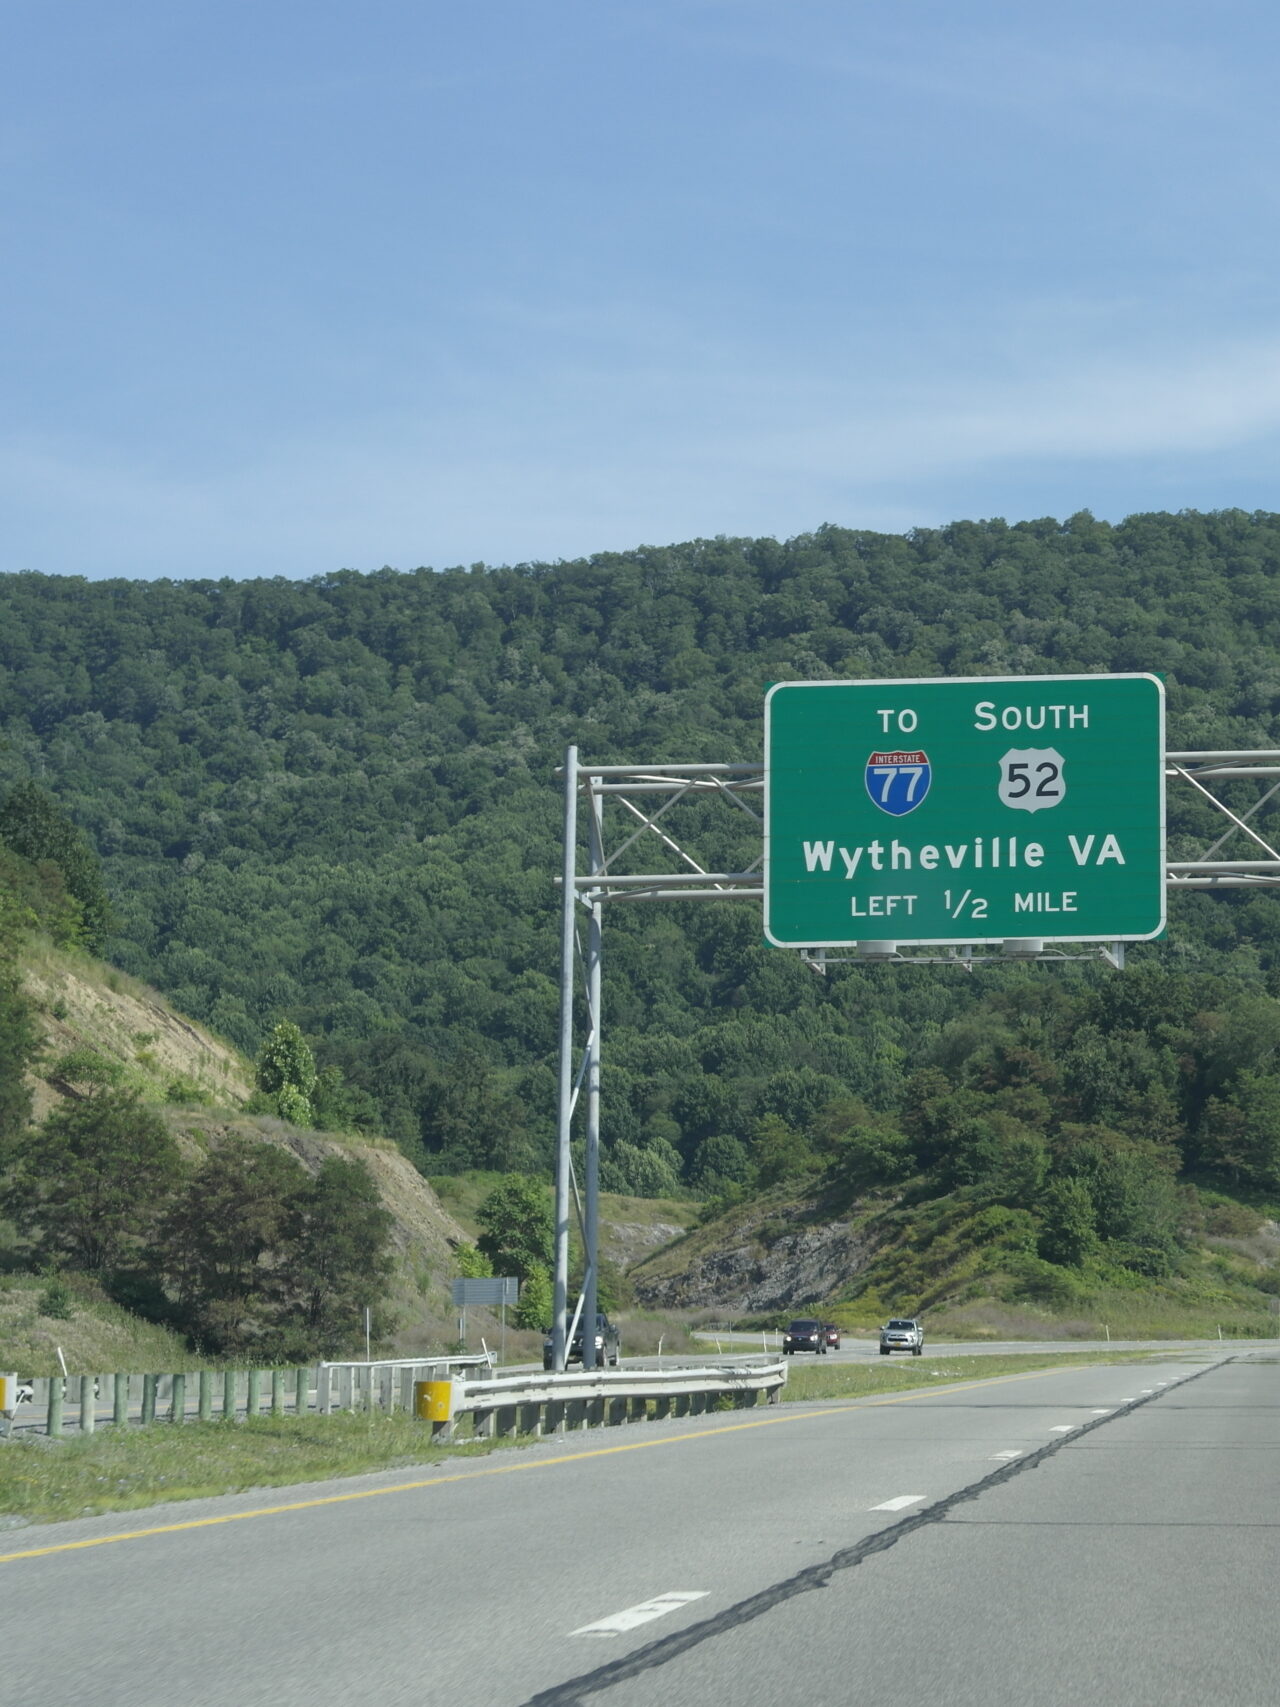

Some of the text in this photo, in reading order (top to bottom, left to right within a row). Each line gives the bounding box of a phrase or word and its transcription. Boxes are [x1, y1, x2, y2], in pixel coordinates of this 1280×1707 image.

[877, 709, 918, 733] TO
[974, 701, 1090, 731] SOUTH
[875, 754, 921, 764] INTERSTATE
[873, 767, 923, 802] 77
[1007, 762, 1060, 798] 52
[802, 833, 1126, 879] Wytheville VA
[850, 889, 1078, 919] LEFT 1/2 MILE
